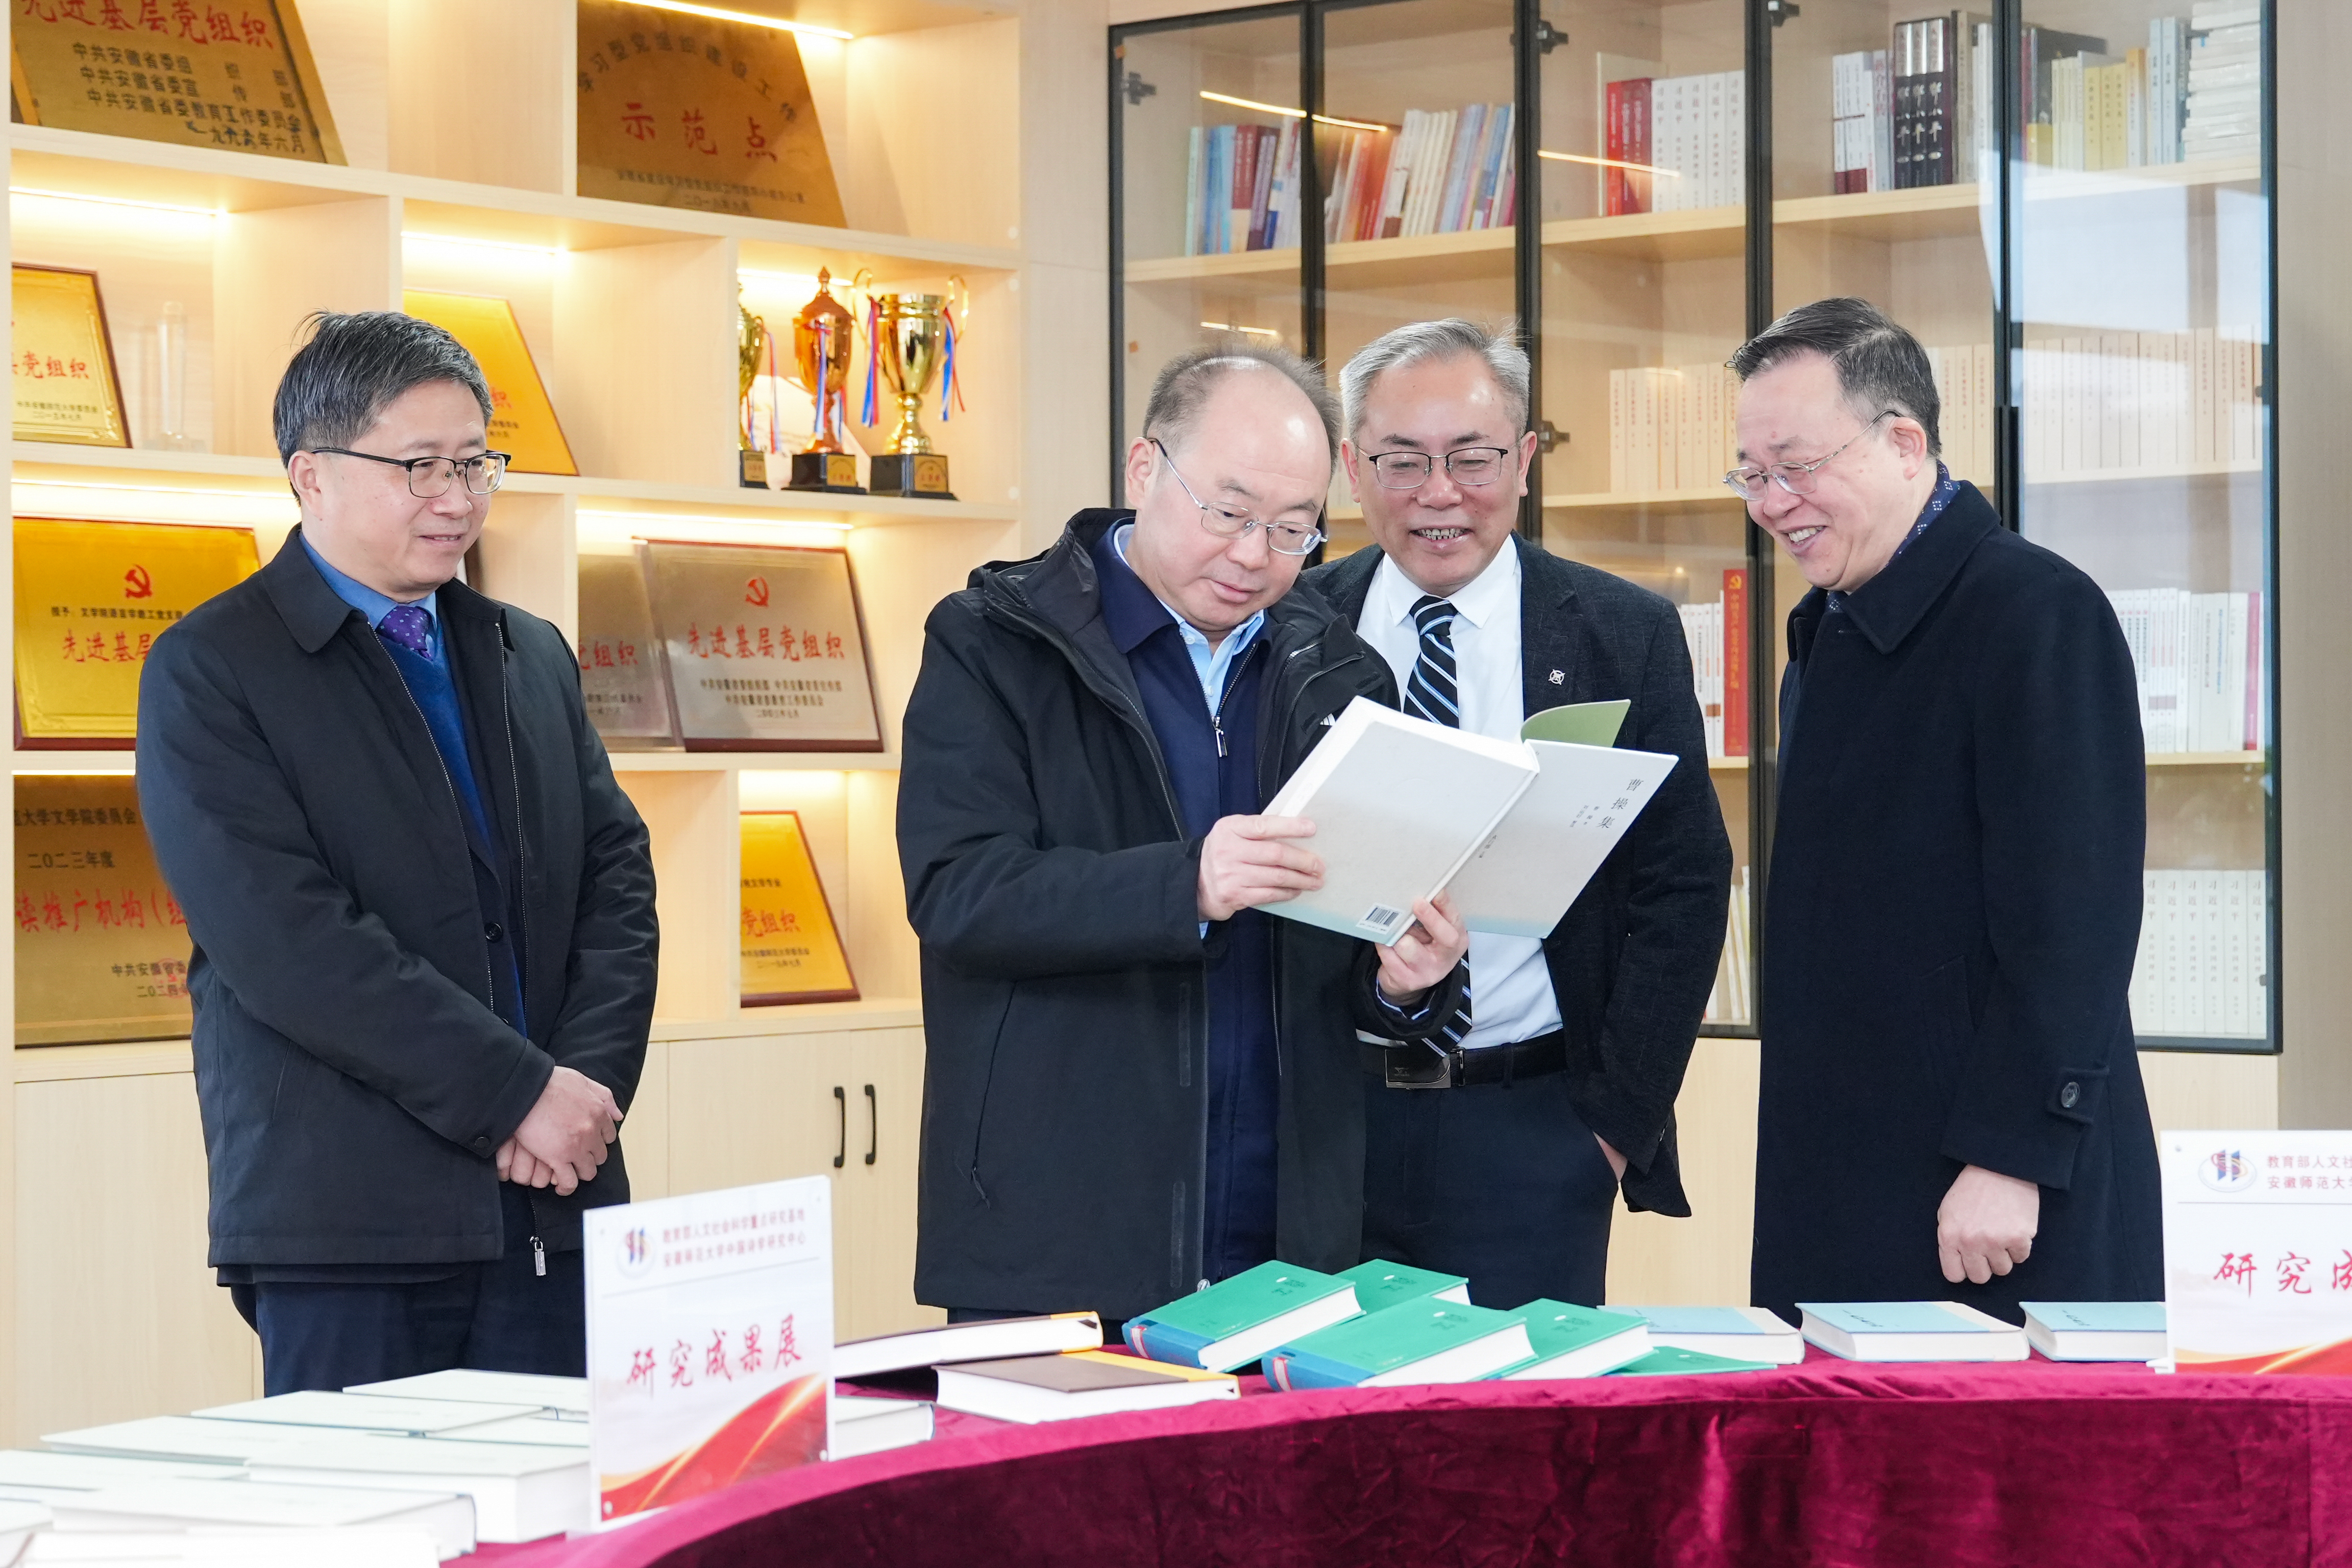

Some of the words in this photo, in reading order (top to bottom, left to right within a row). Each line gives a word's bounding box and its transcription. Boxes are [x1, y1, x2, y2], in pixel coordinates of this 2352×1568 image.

[621, 103, 778, 162] 示范点
[687, 622, 846, 661] 先进基层党组织
[1596, 779, 1644, 828] 曹操集
[2267, 1175, 2352, 1189] 安徽师范大
[627, 1313, 801, 1399] 研究成果展
